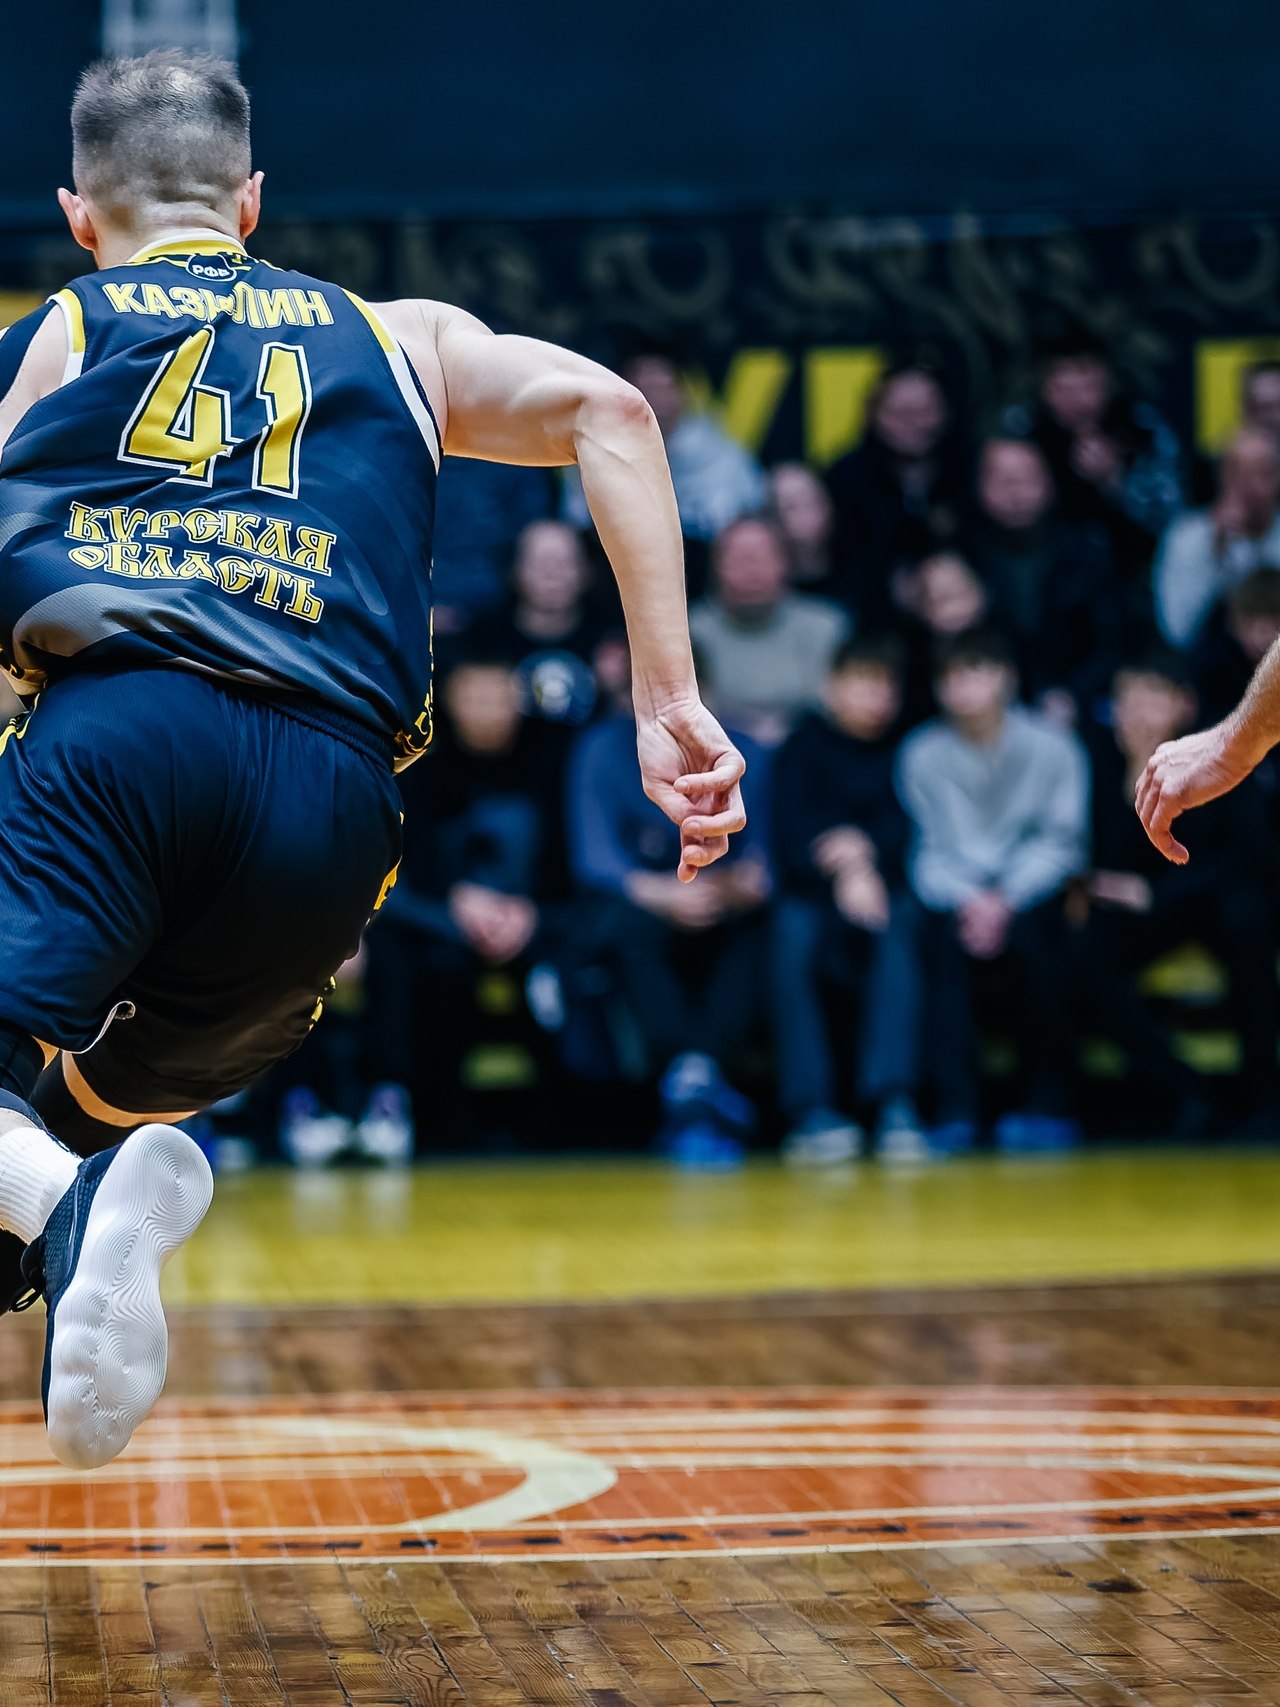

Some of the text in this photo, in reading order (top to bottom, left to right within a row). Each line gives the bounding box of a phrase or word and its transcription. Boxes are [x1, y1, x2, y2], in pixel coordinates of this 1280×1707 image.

[117, 324, 313, 499] 41
[64, 501, 337, 576] КУРСКАЯ
[68, 542, 325, 624] ОБЛАСТЬ
